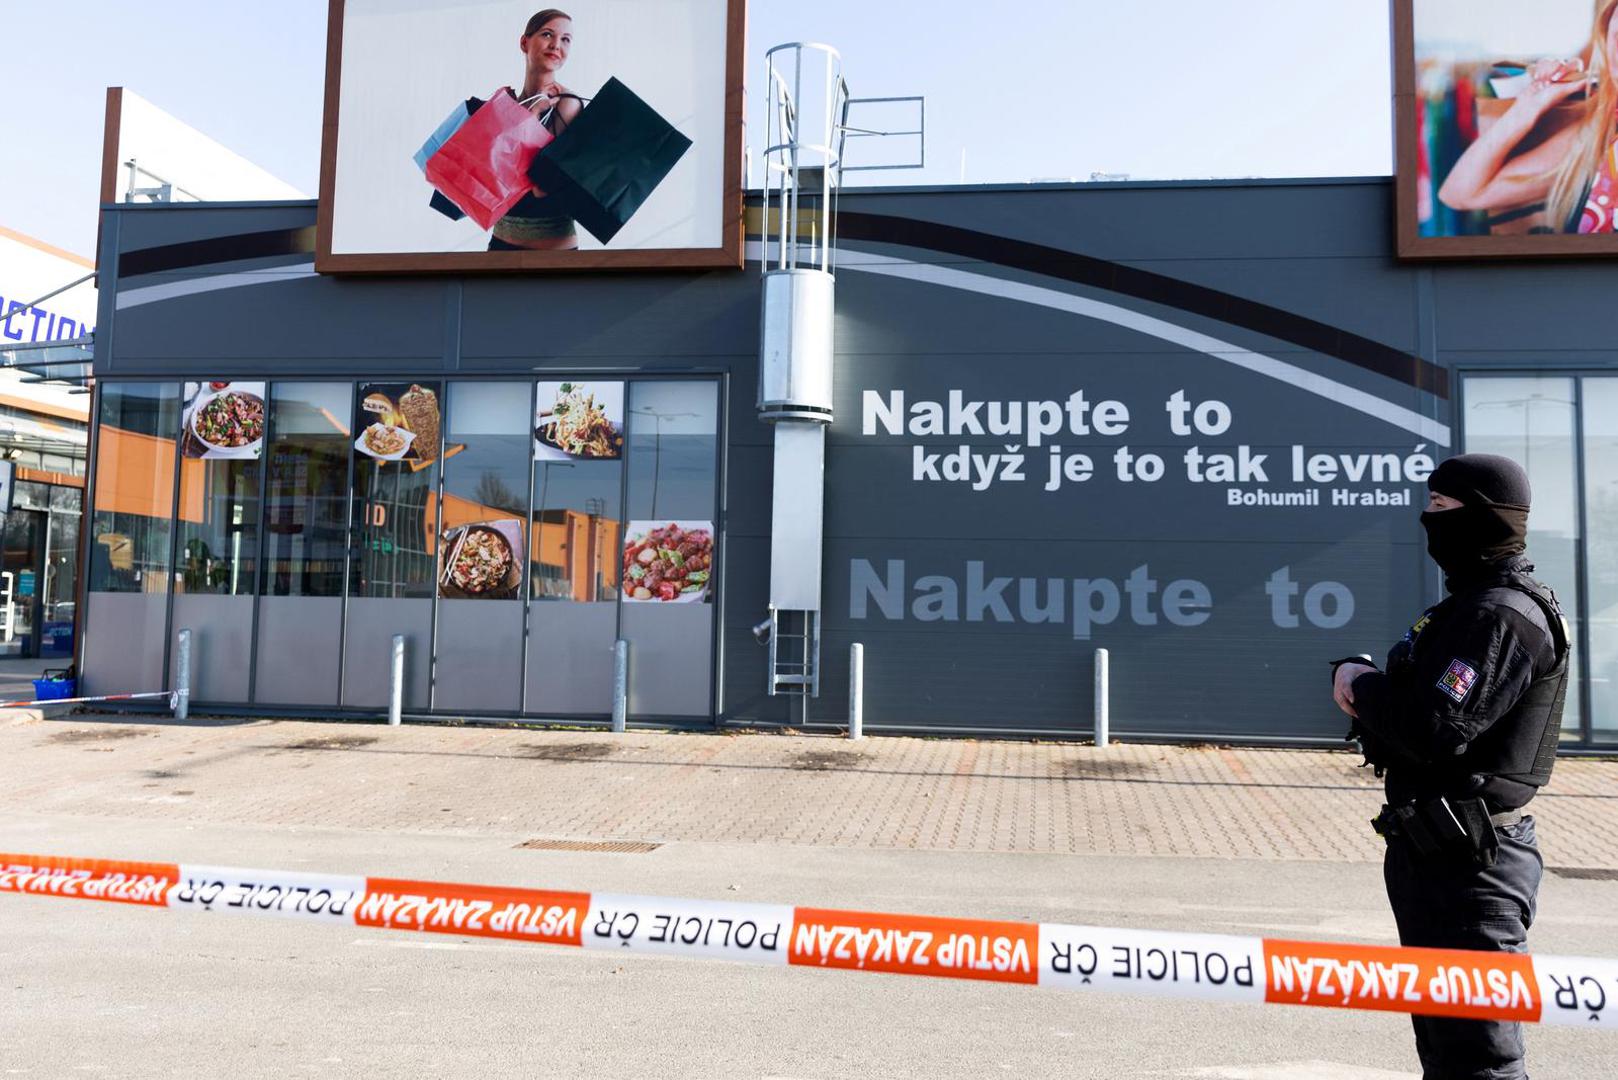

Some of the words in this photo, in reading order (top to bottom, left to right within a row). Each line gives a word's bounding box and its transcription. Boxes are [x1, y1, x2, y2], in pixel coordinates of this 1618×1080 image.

[0, 295, 97, 342] CTIO
[862, 389, 1130, 447] Nakupte
[1166, 389, 1232, 436] to
[912, 444, 1025, 491] když
[1045, 445, 1094, 492] je
[1114, 447, 1165, 482] to
[1184, 446, 1268, 482] tak
[1292, 444, 1434, 483] levné
[1227, 488, 1319, 507] Bohumil
[1331, 488, 1411, 507] Hrabal
[849, 558, 1212, 640] Nakupte
[1265, 565, 1355, 629] to
[178, 879, 225, 911] ČR
[228, 882, 355, 916] POLICIE
[360, 892, 493, 931] ZAKÁZÁN
[489, 902, 577, 938] VSTUP
[594, 910, 639, 947] ČR
[649, 914, 780, 951] POLICIE
[794, 923, 933, 968] ZAKÁZÁN
[936, 934, 1031, 973] VSTUP
[1050, 941, 1098, 984] ČR
[1112, 946, 1254, 987] POLICIE
[1272, 954, 1420, 1005] ZAKÁZÁN
[1429, 964, 1534, 1009] VSTUP
[1549, 974, 1606, 1021] ČR
